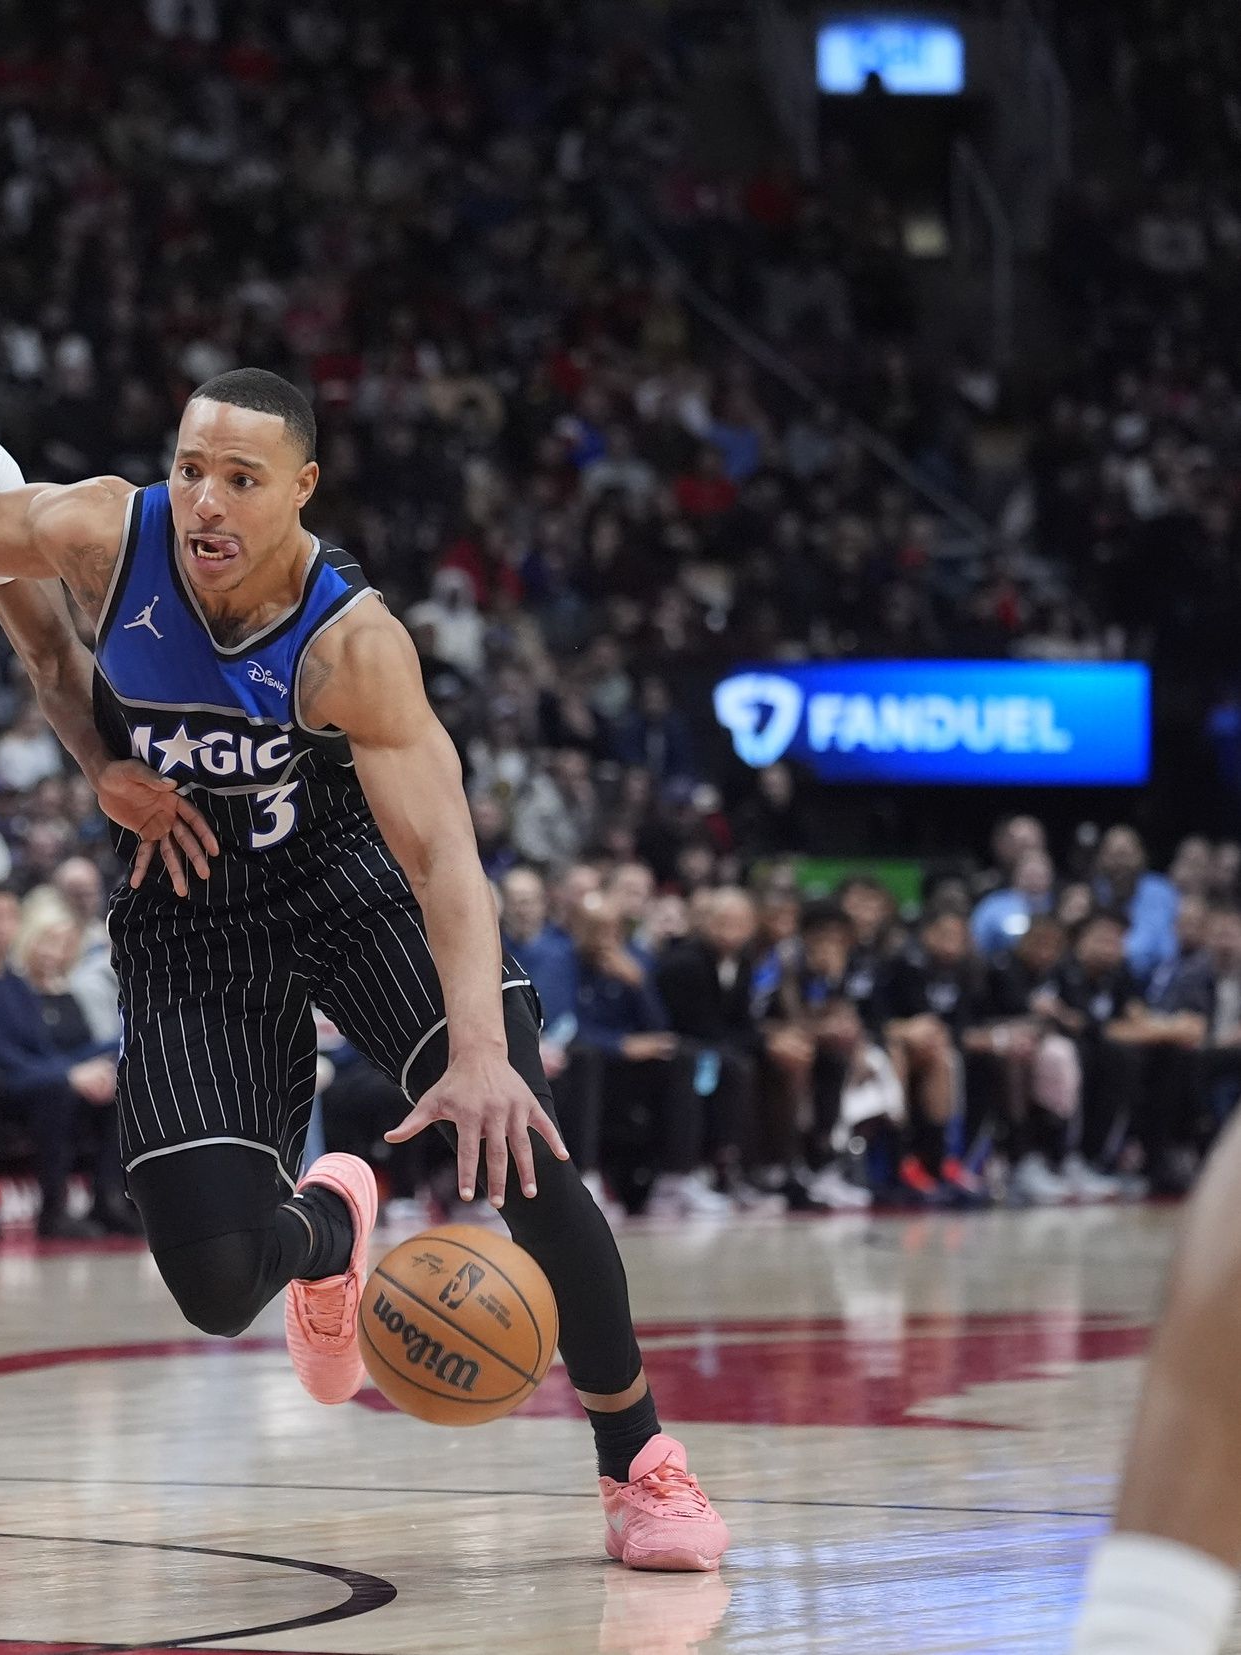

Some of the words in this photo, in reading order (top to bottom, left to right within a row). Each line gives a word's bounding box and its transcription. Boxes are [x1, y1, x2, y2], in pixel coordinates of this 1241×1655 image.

[247, 660, 288, 699] Disney
[806, 693, 1070, 754] FANDUEL
[252, 780, 300, 849] 3
[373, 1289, 481, 1392] Wilson
